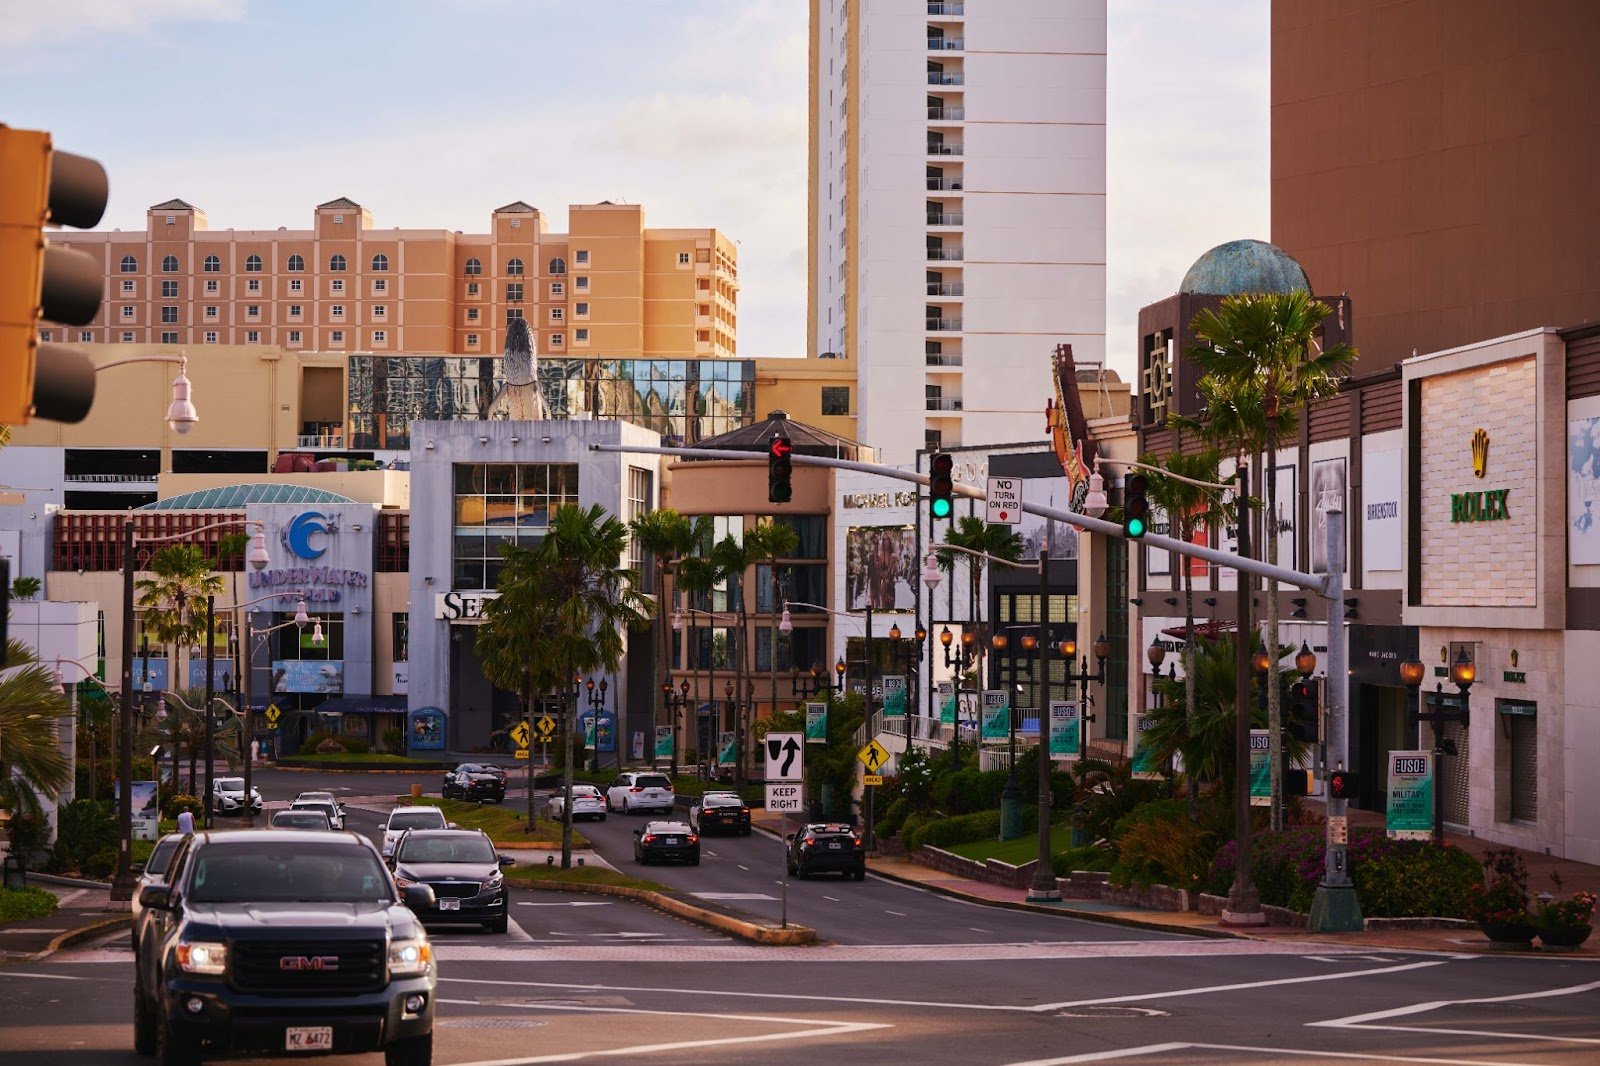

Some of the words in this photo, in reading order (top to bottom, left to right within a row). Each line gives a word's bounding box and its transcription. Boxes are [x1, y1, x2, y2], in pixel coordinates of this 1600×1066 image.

[950, 462, 988, 482] GUC
[997, 480, 1012, 490] NO
[843, 493, 891, 509] MICHAEL
[895, 491, 917, 507] KOR
[995, 492, 1015, 500] TURN
[989, 501, 1000, 509] ON
[1002, 501, 1019, 509] RED
[1367, 501, 1398, 520] BIRKENSTOCK
[1451, 489, 1511, 523] ROLEX
[249, 565, 367, 588] UNDERWATER
[443, 593, 484, 620] SE
[1381, 652, 1397, 660] JACOBS
[1057, 706, 1071, 716] USO
[1142, 719, 1157, 731] USO
[1250, 737, 1268, 749] USO
[1400, 760, 1420, 772] USO
[772, 788, 797, 796] KEEP
[1393, 790, 1425, 798] MILITARY
[771, 800, 798, 808] RIGHT
[280, 956, 339, 970] GMC
[306, 1033, 330, 1045] 6472
